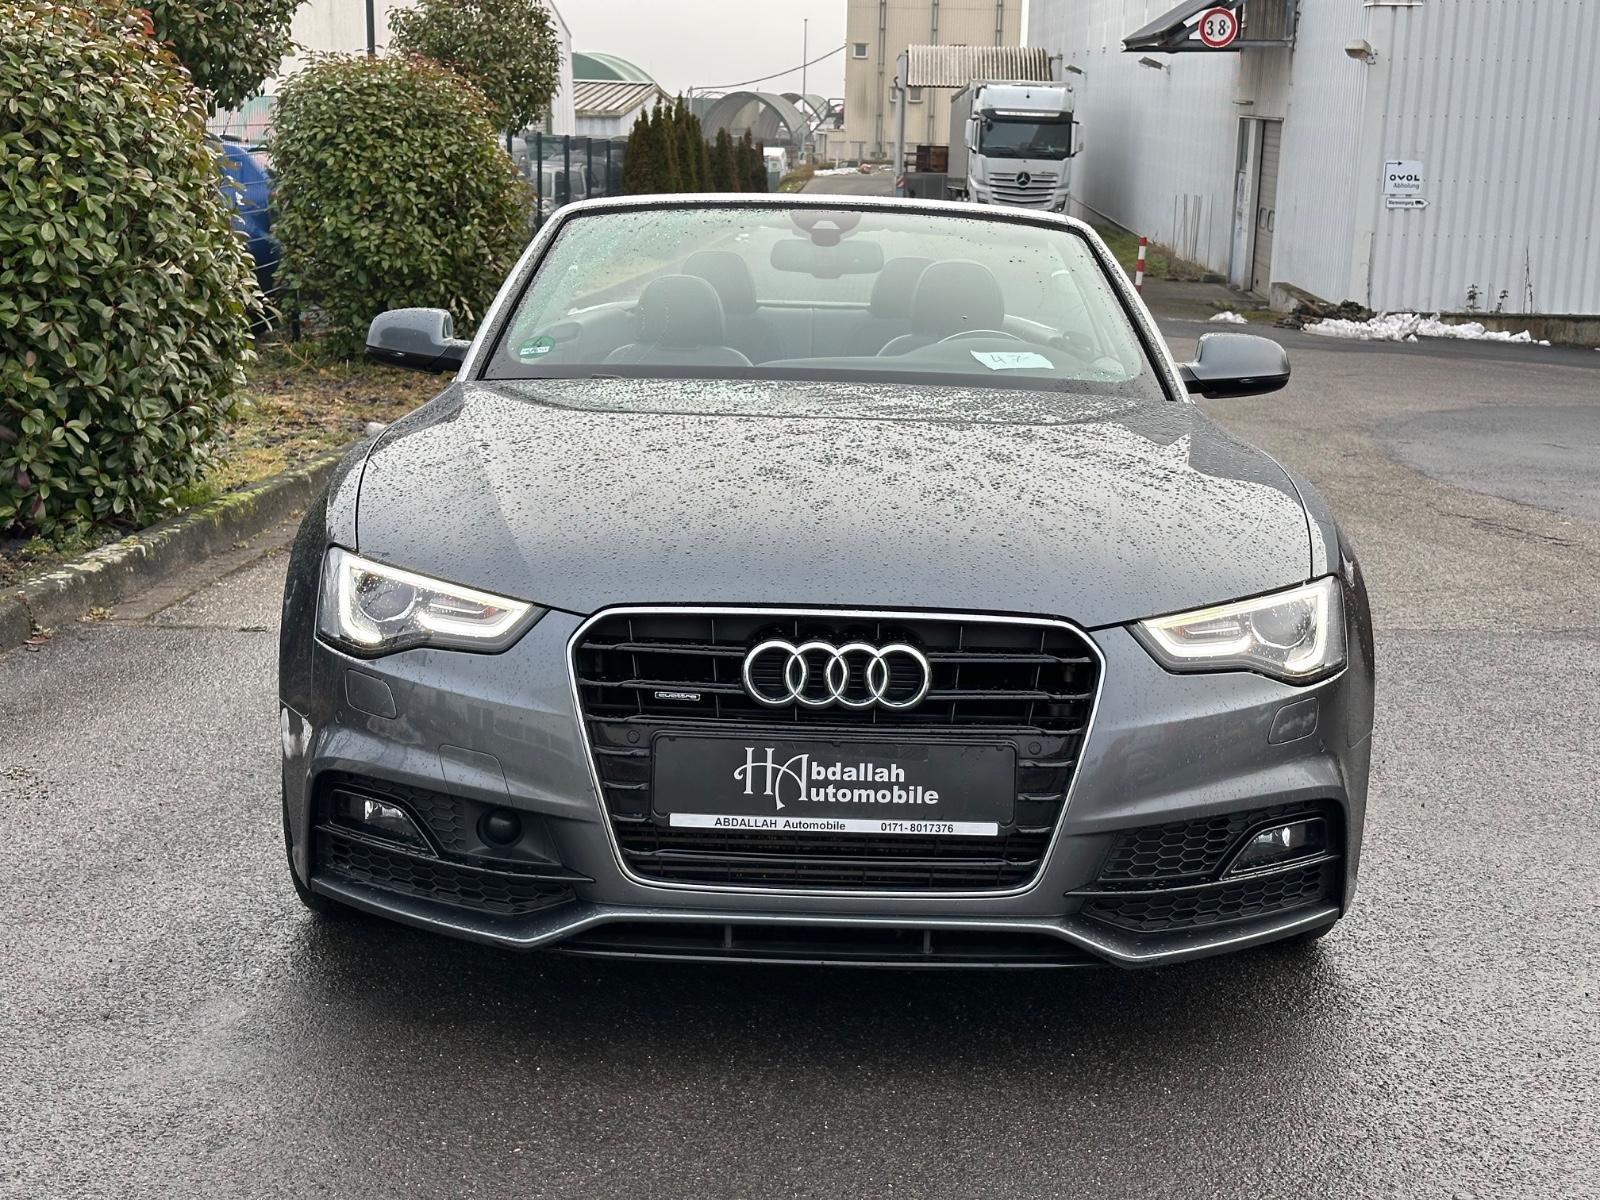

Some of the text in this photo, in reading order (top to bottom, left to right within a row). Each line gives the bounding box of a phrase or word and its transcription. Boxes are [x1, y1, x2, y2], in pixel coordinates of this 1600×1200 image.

[714, 817, 954, 834] ABDALLAH Automobile 0171-8017376
